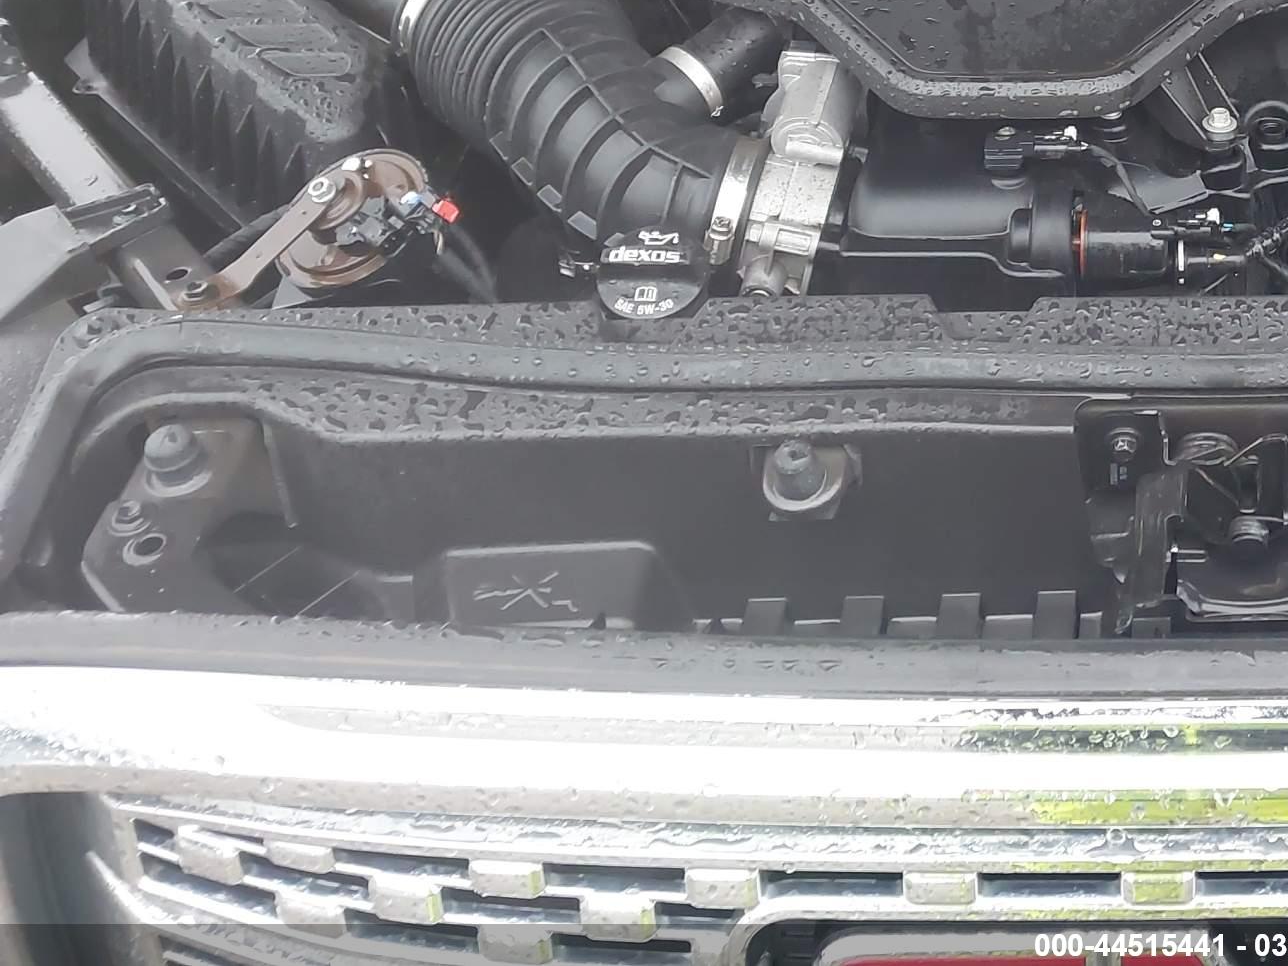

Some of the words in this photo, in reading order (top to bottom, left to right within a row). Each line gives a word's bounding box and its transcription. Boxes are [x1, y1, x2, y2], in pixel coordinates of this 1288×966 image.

[609, 246, 680, 263] dexos
[614, 299, 635, 313] SAE
[637, 299, 674, 315] 5W-30
